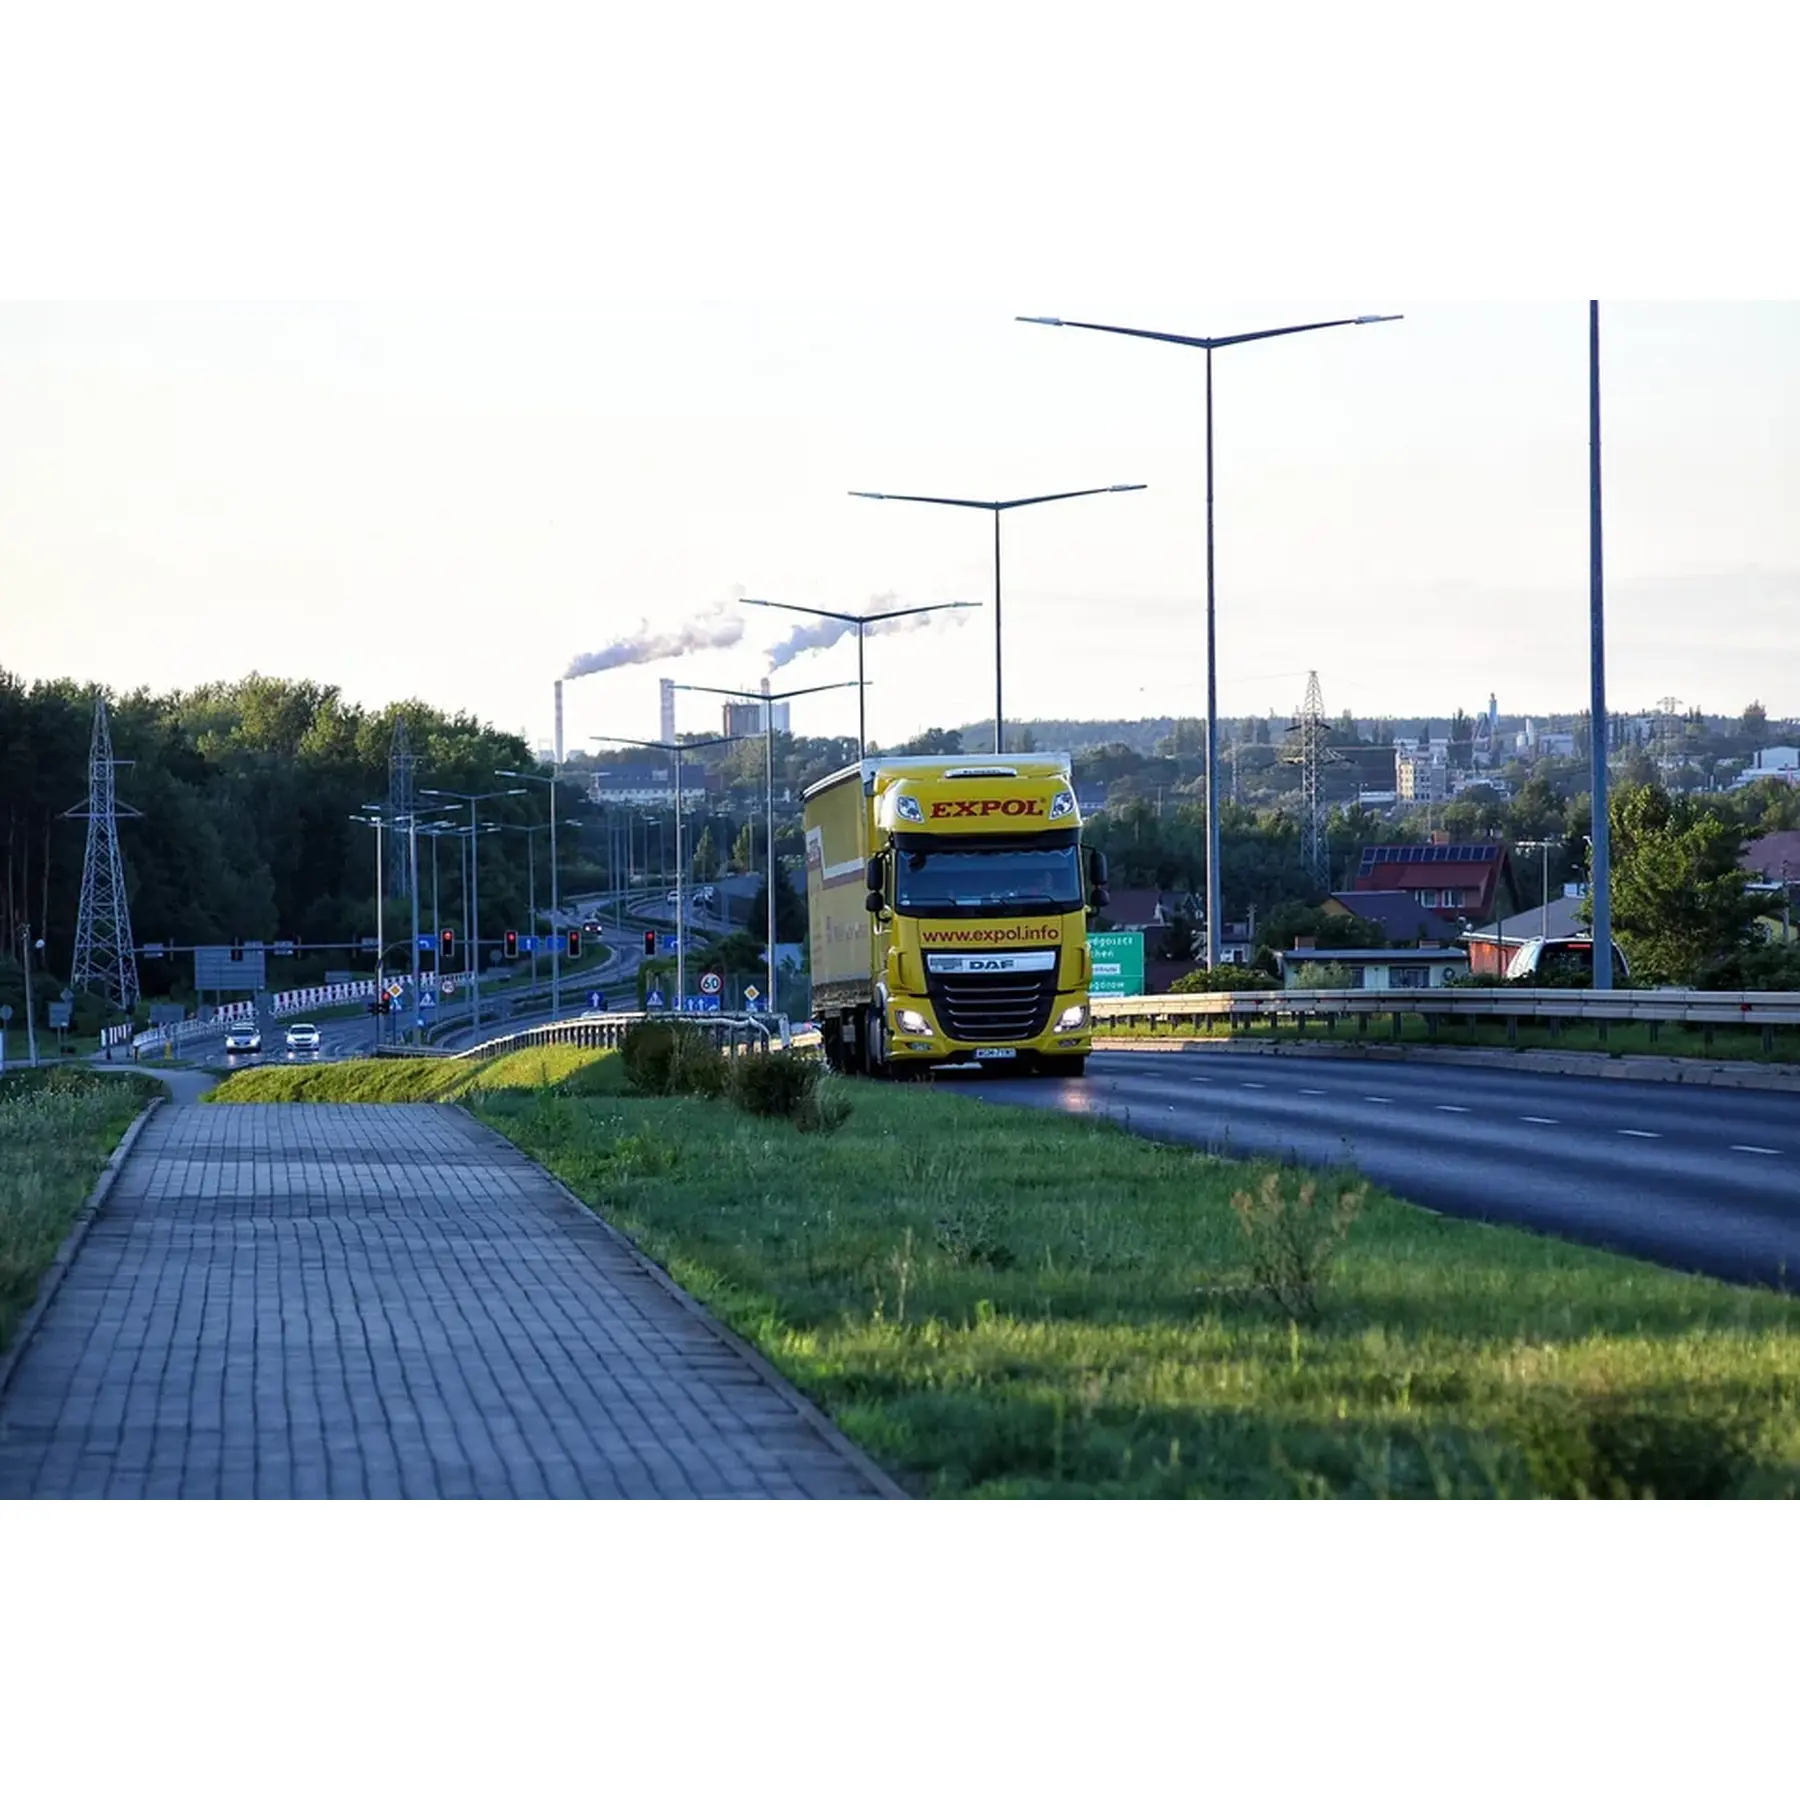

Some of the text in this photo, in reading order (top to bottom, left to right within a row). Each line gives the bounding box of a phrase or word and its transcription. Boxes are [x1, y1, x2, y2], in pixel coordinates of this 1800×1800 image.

[930, 799, 1043, 819] EXPOL
[923, 925, 1059, 944] www.expol.info
[969, 959, 1014, 970] DAF
[704, 976, 718, 989] 60
